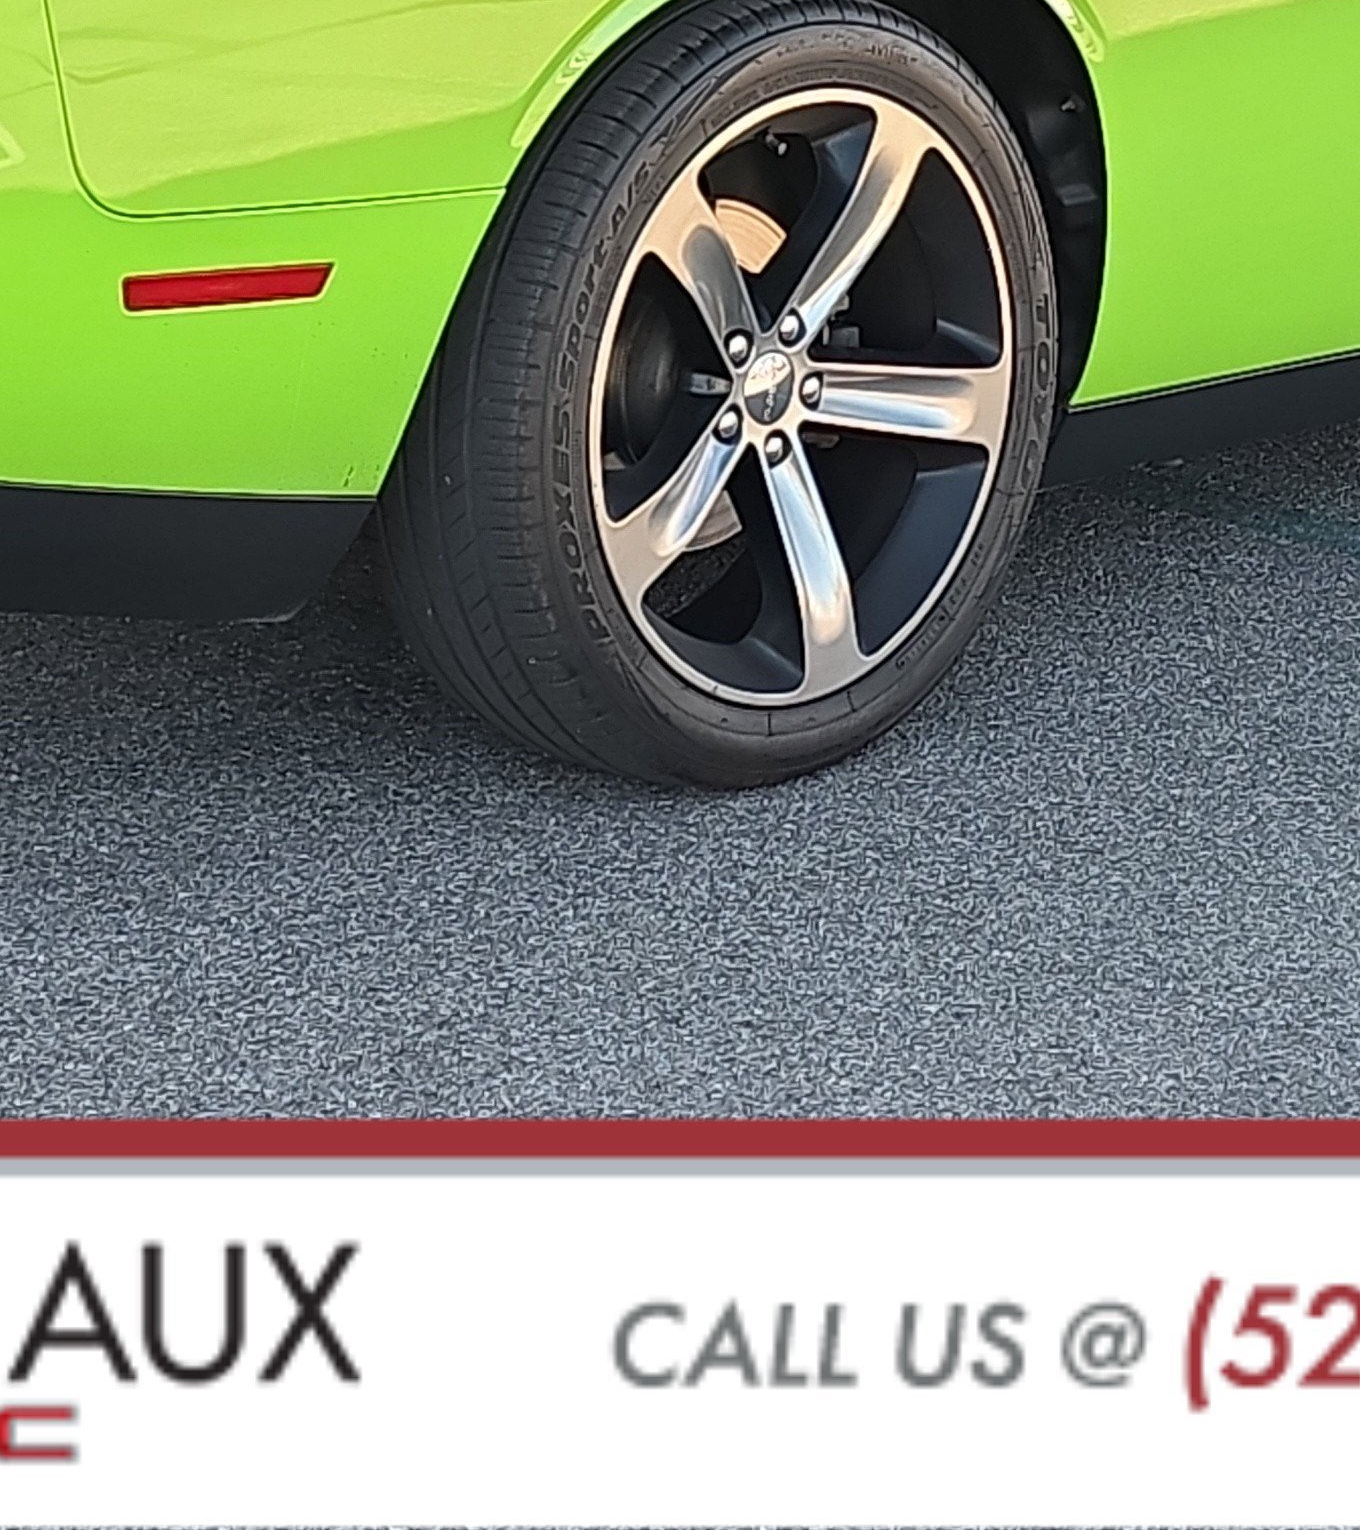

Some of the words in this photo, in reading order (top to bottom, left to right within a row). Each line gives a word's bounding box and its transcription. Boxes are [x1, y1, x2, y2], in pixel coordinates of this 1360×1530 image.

[555, 236, 609, 394] Sport
[1019, 292, 1052, 491] TOYO
[551, 400, 613, 643] PROXES
